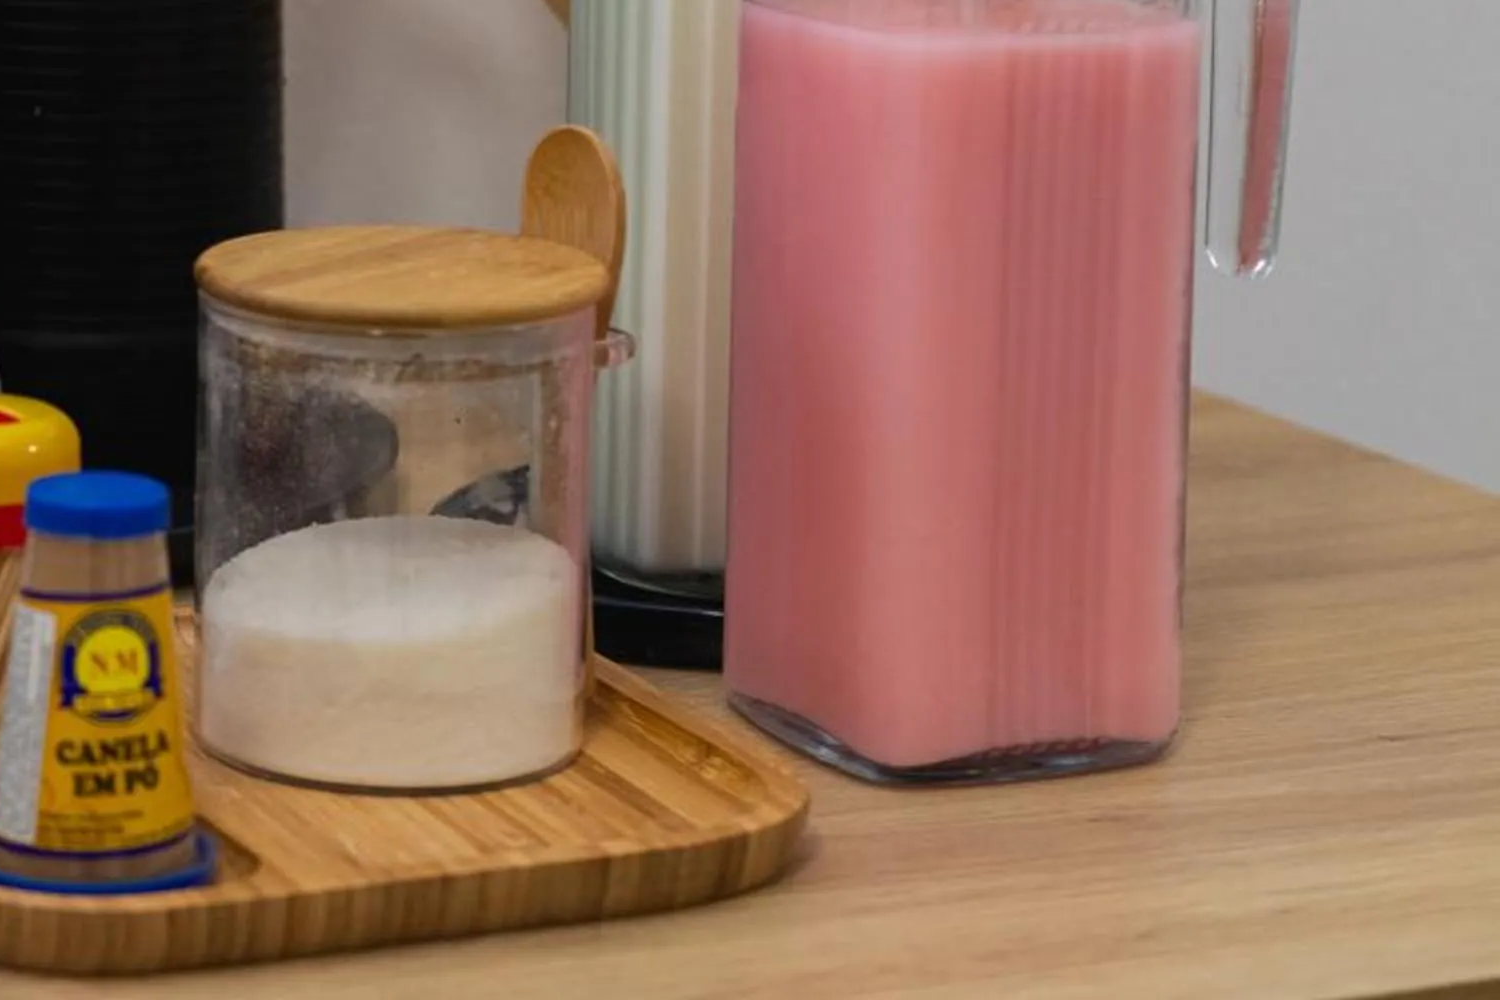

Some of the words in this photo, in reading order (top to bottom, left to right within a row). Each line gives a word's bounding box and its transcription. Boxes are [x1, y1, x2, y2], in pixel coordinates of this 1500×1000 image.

[56, 729, 171, 766] CANELA
[73, 772, 117, 798] EM
[125, 763, 160, 795] PÓ
